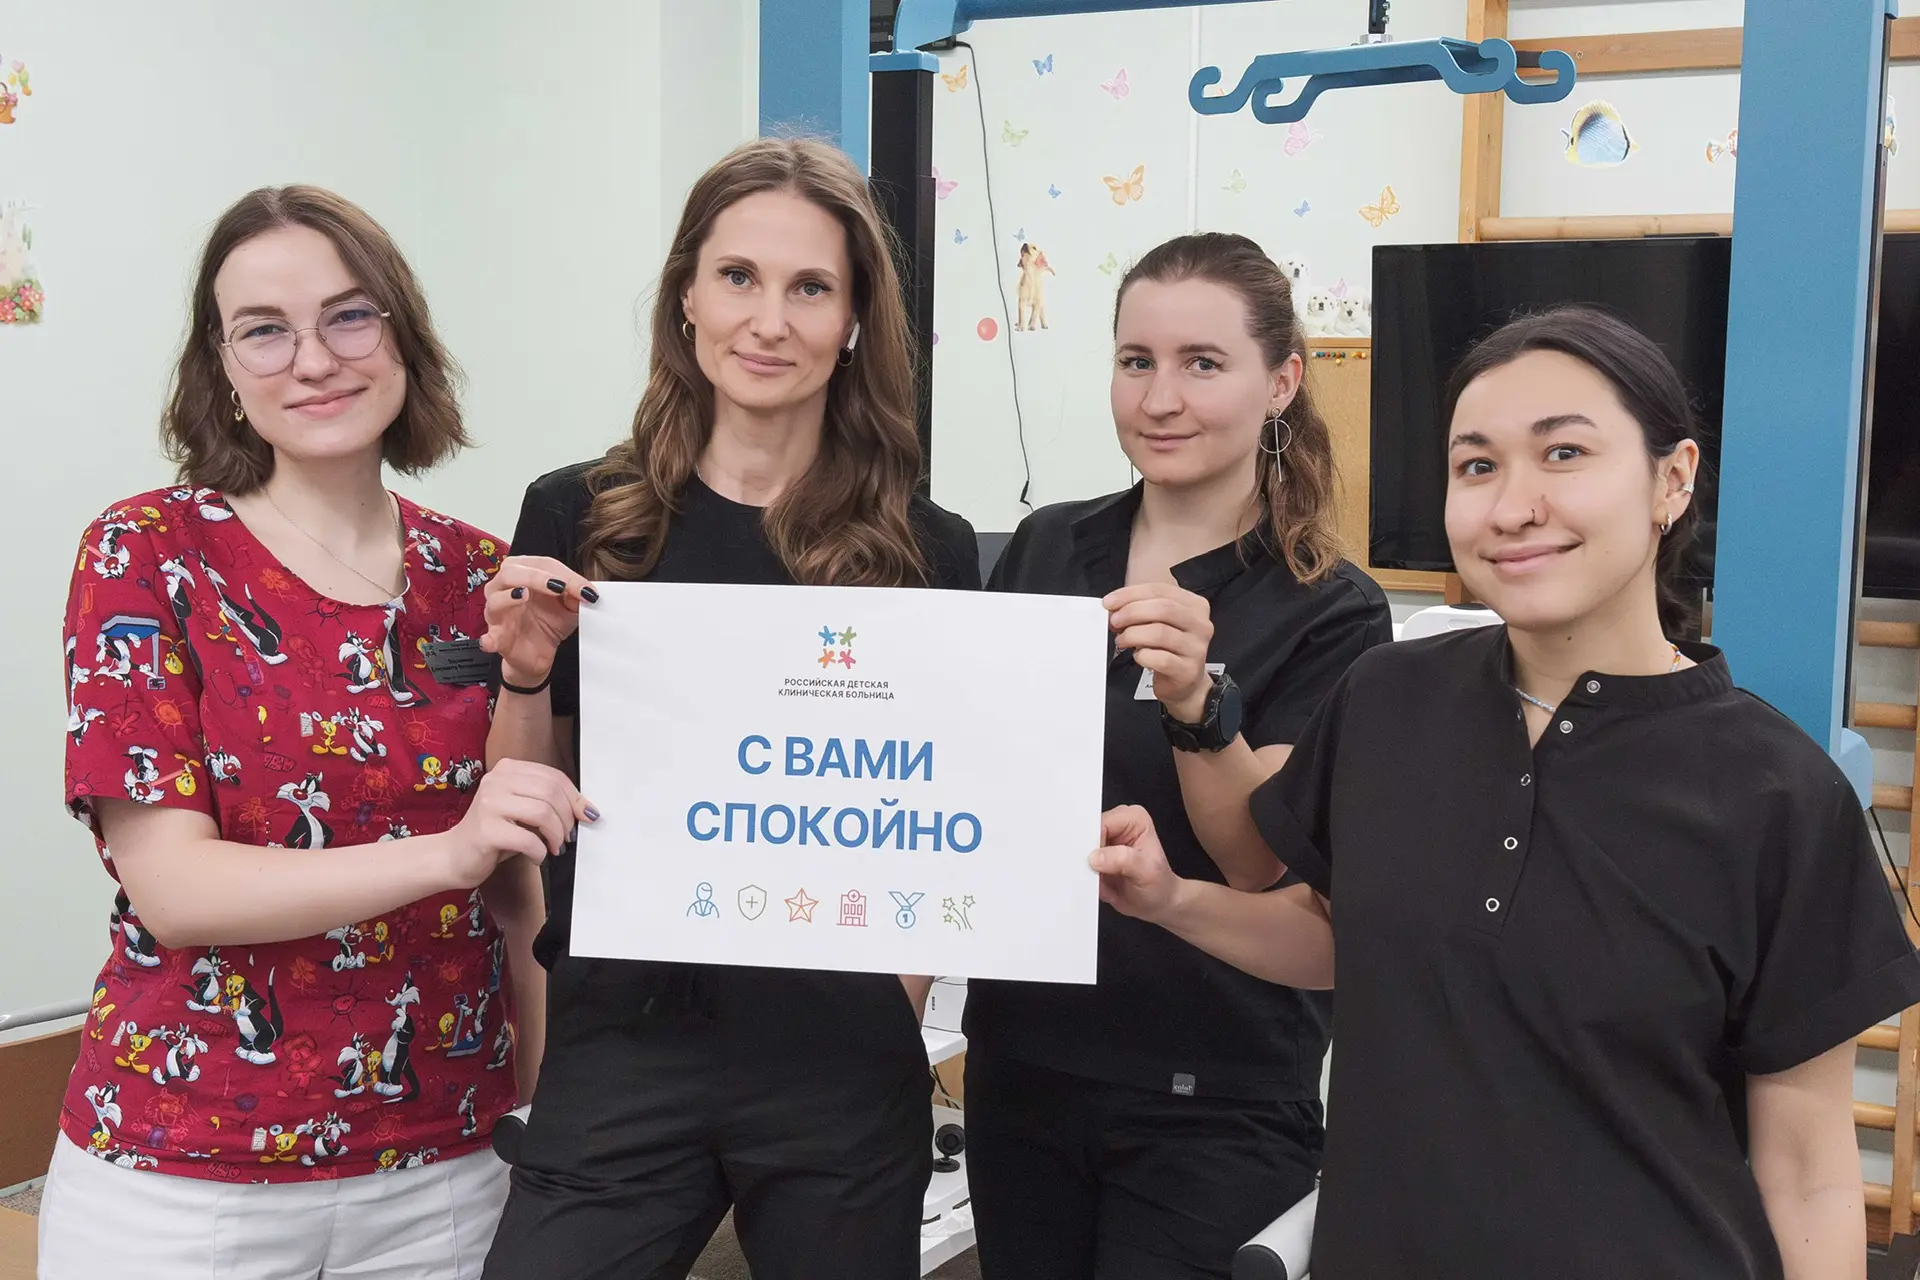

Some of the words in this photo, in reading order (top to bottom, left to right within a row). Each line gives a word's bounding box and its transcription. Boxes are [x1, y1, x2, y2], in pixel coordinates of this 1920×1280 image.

[784, 677, 845, 688] РОССИЙСКАЯ
[847, 680, 889, 689] ДЕТСКАЯ
[778, 689, 844, 698] КЛИНИЧЕСКАЯ
[845, 691, 895, 700] БОЛЬНИЦА
[737, 734, 772, 775] С
[784, 736, 934, 782] ВАМИ
[686, 797, 983, 854] СПОКОЙНО
[902, 913, 908, 923] 1
